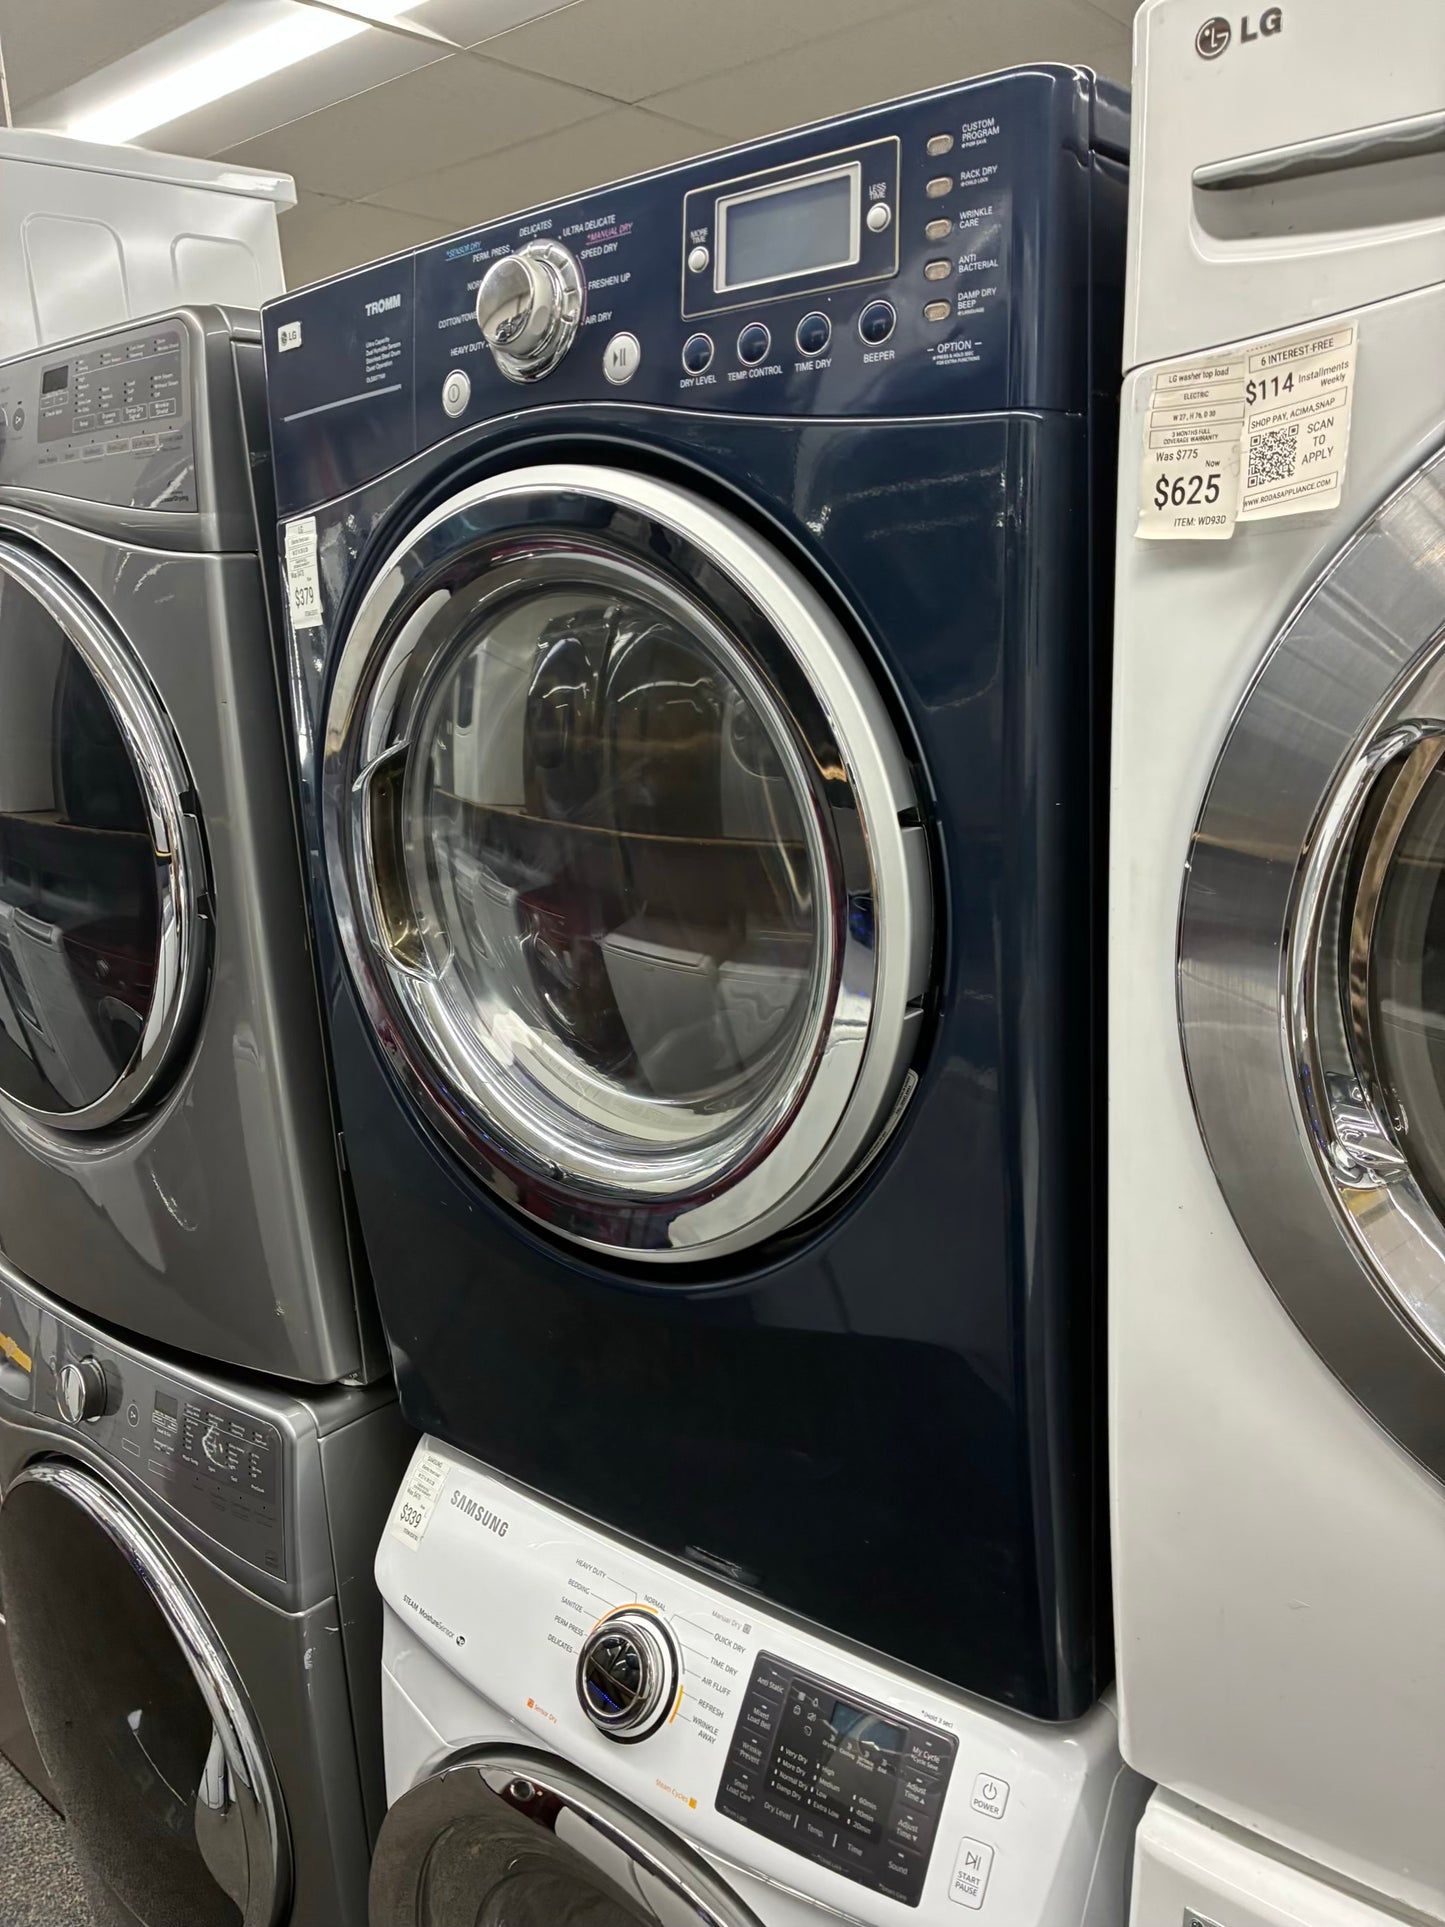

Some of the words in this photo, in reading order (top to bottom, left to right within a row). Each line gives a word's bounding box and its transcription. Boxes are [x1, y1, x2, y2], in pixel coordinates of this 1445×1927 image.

[1241, 7, 1282, 44] LG
[962, 117, 994, 132] CUSTOM
[962, 126, 1000, 142] PROGRAM
[960, 168, 980, 180] RACK
[982, 164, 998, 176] DRY
[869, 182, 886, 196] LESS
[869, 191, 886, 201] TIME
[960, 206, 993, 220] WRINKLE
[519, 220, 552, 237] DELICATES
[562, 224, 584, 237] ULTRA
[584, 214, 616, 231] DELICATE
[619, 222, 633, 233] DRY
[960, 218, 979, 229] CARE
[690, 227, 708, 239] MORE
[693, 235, 706, 245] TIME
[491, 244, 511, 257] PRESS
[580, 247, 602, 259] SPEED
[603, 242, 618, 253] DRY
[958, 259, 998, 274] BACTERIAL
[959, 254, 977, 264] ANTI
[588, 275, 620, 290] FRESHEN
[620, 272, 631, 282] UP
[958, 290, 980, 301] DAMP
[981, 287, 997, 296] DRY
[365, 293, 401, 316] TROMM
[958, 300, 976, 310] BEEP
[585, 315, 597, 325] AIR
[598, 311, 612, 322] DRY
[451, 345, 468, 357] HEAVY
[469, 341, 486, 352] DUTY
[937, 340, 971, 353] OPTION
[1261, 356, 1266, 366] 6
[1268, 338, 1334, 365] INTEREST-FREE
[863, 350, 895, 364] BEEPER
[794, 361, 814, 372] TIME
[815, 358, 832, 370] DRY
[1298, 361, 1349, 383] Installments
[728, 371, 747, 382] TEMP.
[749, 365, 783, 379] CONTROL
[1169, 375, 1178, 384] LG
[1179, 372, 1201, 382] washer
[1203, 371, 1213, 379] top
[1214, 367, 1229, 376] load
[1321, 373, 1346, 387] Weekly
[679, 378, 695, 389] DRY
[696, 374, 717, 386] LEVEL
[1246, 372, 1294, 406] $114
[1184, 391, 1209, 400] ELECTRIC
[1251, 416, 1271, 429] SHOP
[1272, 412, 1288, 423] PAY,
[1307, 417, 1334, 434] SCAN
[1163, 437, 1189, 445] COVERAGE
[1190, 434, 1218, 442] WARRANTY
[1176, 429, 1198, 437] MONTHS
[1313, 434, 1326, 447] TO
[1156, 452, 1174, 461] Was
[1176, 448, 1198, 460] $775
[1301, 446, 1334, 465] APPLY
[1205, 460, 1221, 468] Now
[1154, 474, 1221, 511] $625
[1174, 518, 1196, 527] ITEM:
[295, 586, 314, 608] $379
[400, 1502, 422, 1528] $339
[450, 1489, 510, 1538] SAMSUNG
[576, 1559, 592, 1572] HEAVY
[593, 1567, 607, 1578] DUTY
[568, 1578, 590, 1595] BEDDING
[561, 1596, 584, 1614] SANITIZE
[644, 1594, 666, 1612] NORMAL
[555, 1615, 569, 1628] PERM
[569, 1623, 584, 1637] PRESS
[712, 1610, 731, 1626] Manual
[731, 1619, 742, 1630] Dry
[548, 1634, 573, 1653] DELICATES
[714, 1633, 733, 1647] QUICK
[733, 1642, 746, 1654] DRY
[710, 1657, 725, 1669] TIME
[725, 1664, 738, 1676] DRY
[702, 1676, 712, 1688] AIR
[712, 1682, 732, 1697] FLUFF
[757, 1676, 768, 1688] Anti
[769, 1681, 784, 1694] Static
[534, 1704, 548, 1718] Sensor
[698, 1698, 724, 1719] REFRESH
[753, 1707, 770, 1720] Mixed
[692, 1715, 719, 1736] WRINKLE
[747, 1714, 760, 1726] Load
[698, 1730, 717, 1744] AWAY
[742, 1741, 762, 1757] Wrinkle
[785, 1748, 798, 1760] Very
[799, 1754, 808, 1765] Dry
[913, 1746, 923, 1758] My
[923, 1751, 941, 1763] Cycle
[739, 1750, 760, 1765] Prevent
[782, 1759, 795, 1771] More
[796, 1765, 806, 1777] Dry
[822, 1765, 835, 1777] High
[734, 1779, 748, 1791] Small
[779, 1771, 798, 1786] Normal
[799, 1779, 808, 1791] Dry
[819, 1777, 840, 1792] Medium
[656, 1778, 671, 1793] Steam
[671, 1788, 689, 1803] Cycles
[726, 1784, 739, 1796] Load
[776, 1783, 792, 1796] Damp
[792, 1789, 801, 1801] Dry
[815, 1787, 828, 1799] Low
[904, 1790, 919, 1803] Time
[906, 1782, 927, 1796] Adjust
[764, 1801, 775, 1813] Dry
[776, 1807, 792, 1820] Level
[813, 1801, 827, 1813] Extra
[828, 1807, 840, 1819] Low
[973, 1798, 999, 1814] POWER
[898, 1819, 919, 1834] Adjust
[896, 1828, 911, 1841] Time
[848, 1843, 863, 1856] Time
[888, 1861, 908, 1875] Sound
[958, 1871, 980, 1886] START
[955, 1881, 977, 1896] PAUSE
